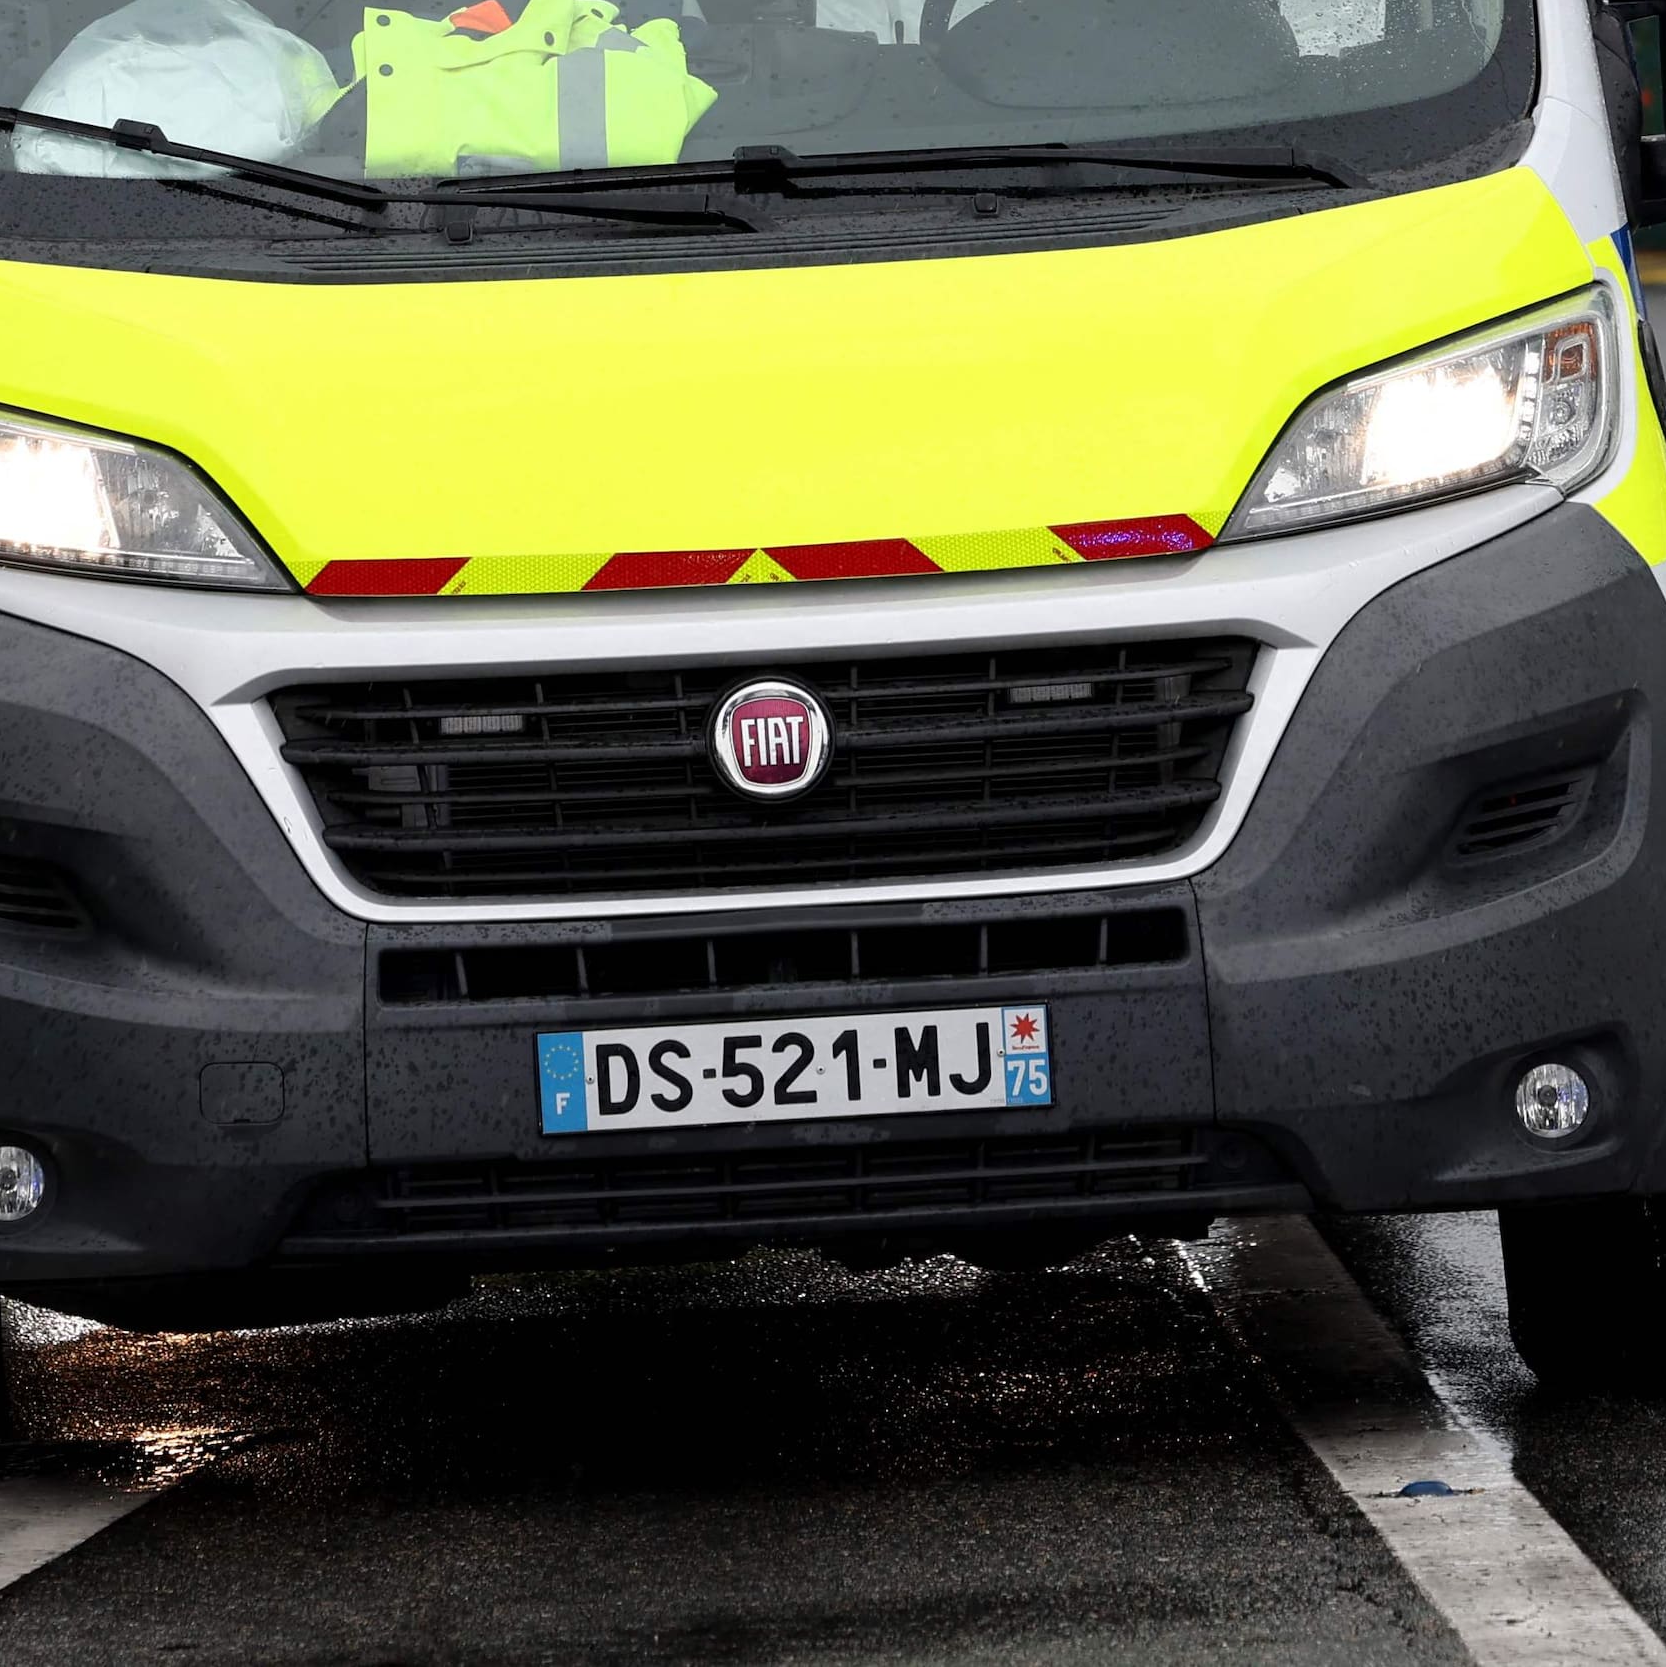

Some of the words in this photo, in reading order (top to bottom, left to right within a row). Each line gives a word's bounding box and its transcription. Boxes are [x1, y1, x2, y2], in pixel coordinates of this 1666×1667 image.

[740, 715, 804, 767] FIAT
[595, 1021, 992, 1116] DS-521-MJ
[1006, 1057, 1049, 1097] 75
[555, 1091, 571, 1116] F
